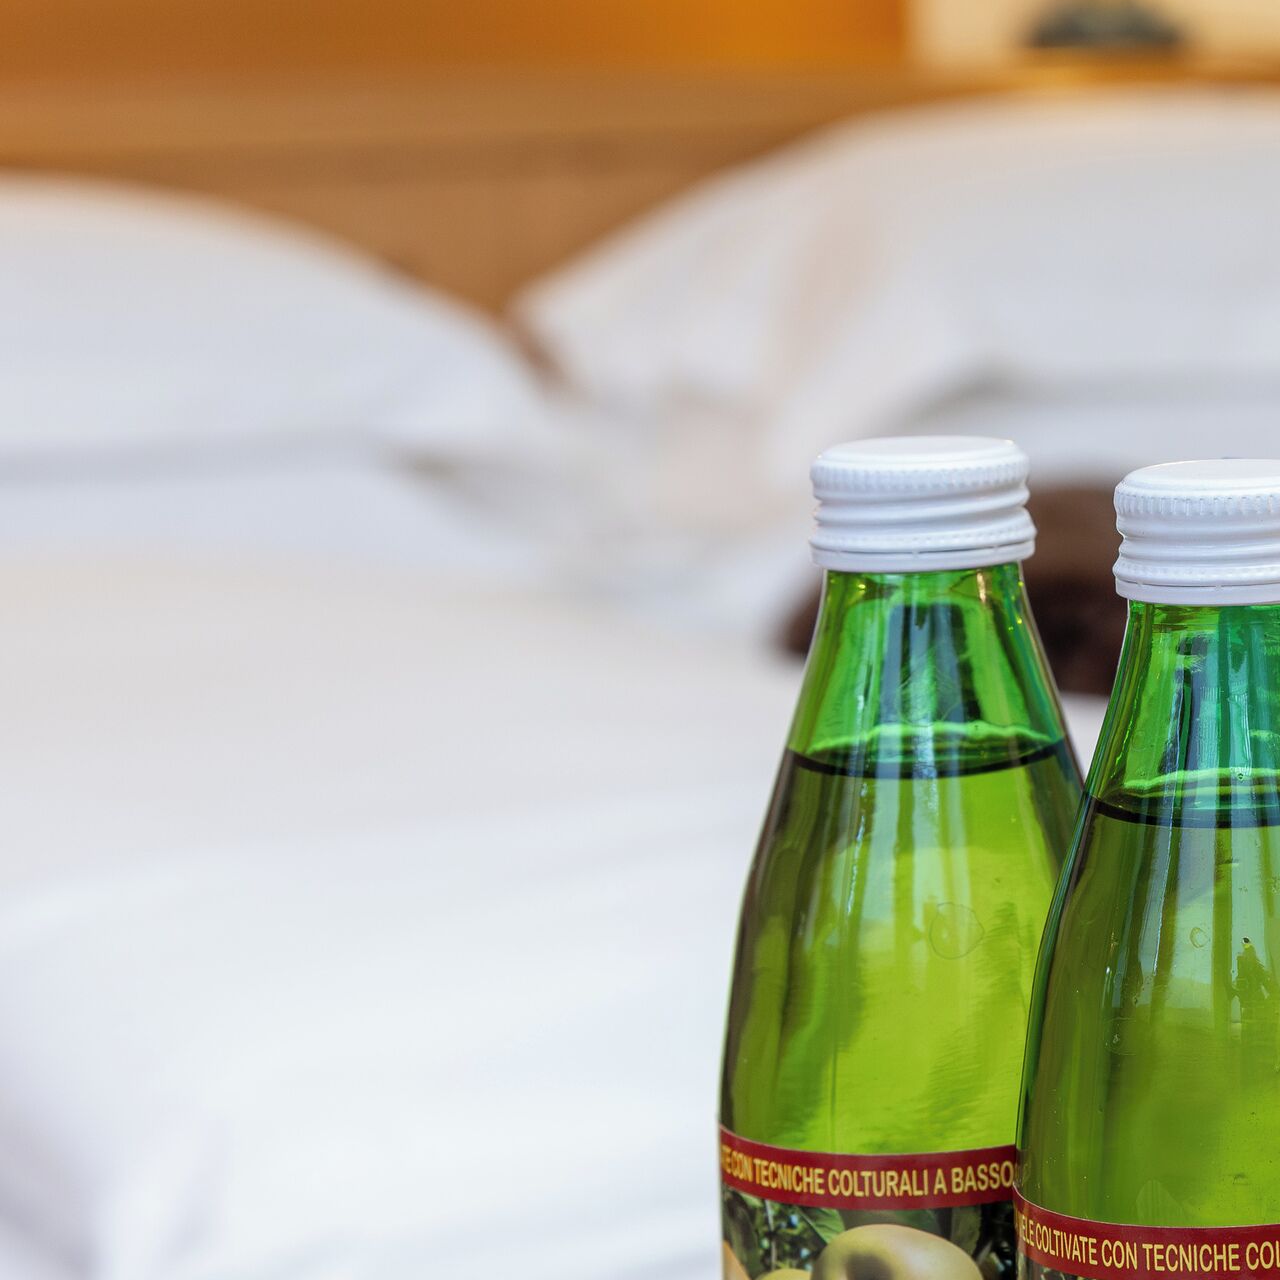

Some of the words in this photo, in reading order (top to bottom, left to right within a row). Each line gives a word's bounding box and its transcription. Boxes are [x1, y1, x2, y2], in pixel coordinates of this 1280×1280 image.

[731, 1150, 754, 1183] CON
[753, 1157, 826, 1195] TECNICHE
[827, 1168, 928, 1198] COLTURALI
[933, 1167, 948, 1195] A
[950, 1160, 1015, 1194] BASSO
[1035, 1222, 1099, 1266] COLTIVATE
[1101, 1238, 1139, 1271] CON
[1141, 1242, 1242, 1272] TECNICHE
